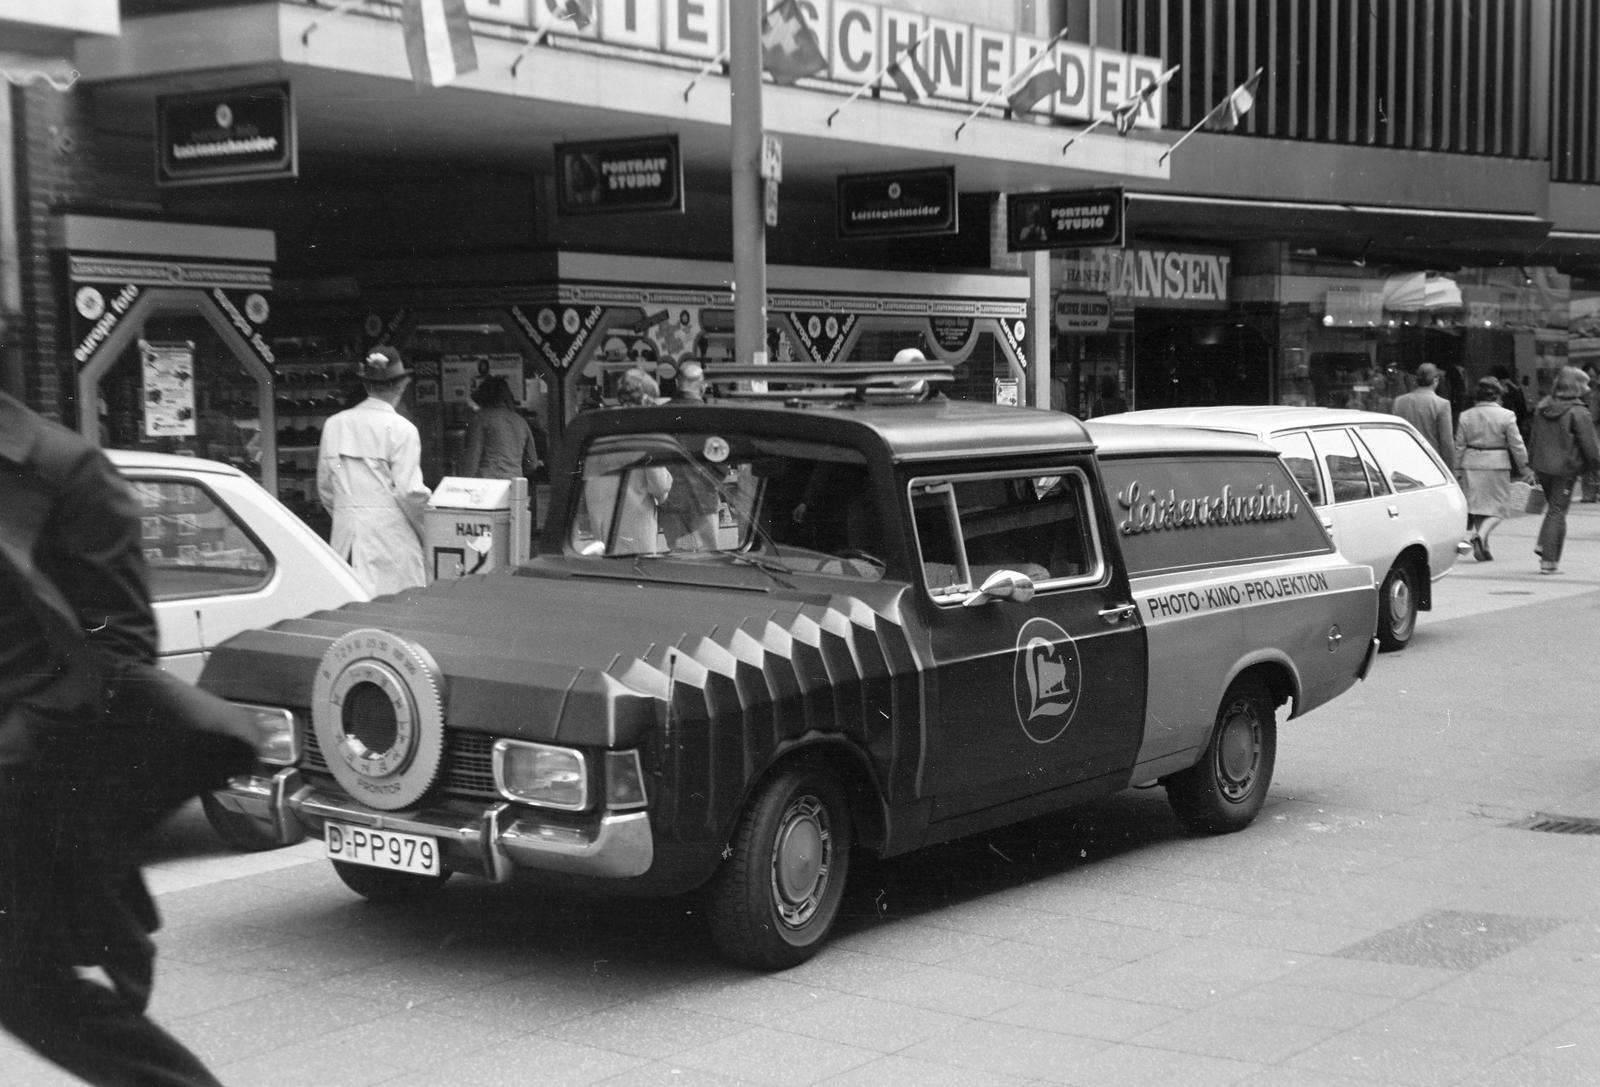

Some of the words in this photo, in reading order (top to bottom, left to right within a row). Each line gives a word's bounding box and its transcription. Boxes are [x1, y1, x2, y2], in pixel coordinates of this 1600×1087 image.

[602, 157, 667, 175] PORTRAIT
[609, 173, 661, 189] STUDIO
[1051, 205, 1110, 218] PORTRAIT
[1057, 217, 1104, 230] STUDIO
[74, 312, 118, 362] europa
[110, 284, 139, 315] foto
[562, 328, 591, 368] europa
[585, 305, 607, 331] foto
[790, 311, 813, 351] europa
[841, 312, 857, 336] foto
[251, 333, 276, 364] foto
[1000, 317, 1018, 351] europa
[1016, 347, 1029, 369] foto
[1147, 592, 1201, 618] PHOTO
[1207, 585, 1241, 609] KINO
[1244, 572, 1329, 601] PROJEKTION
